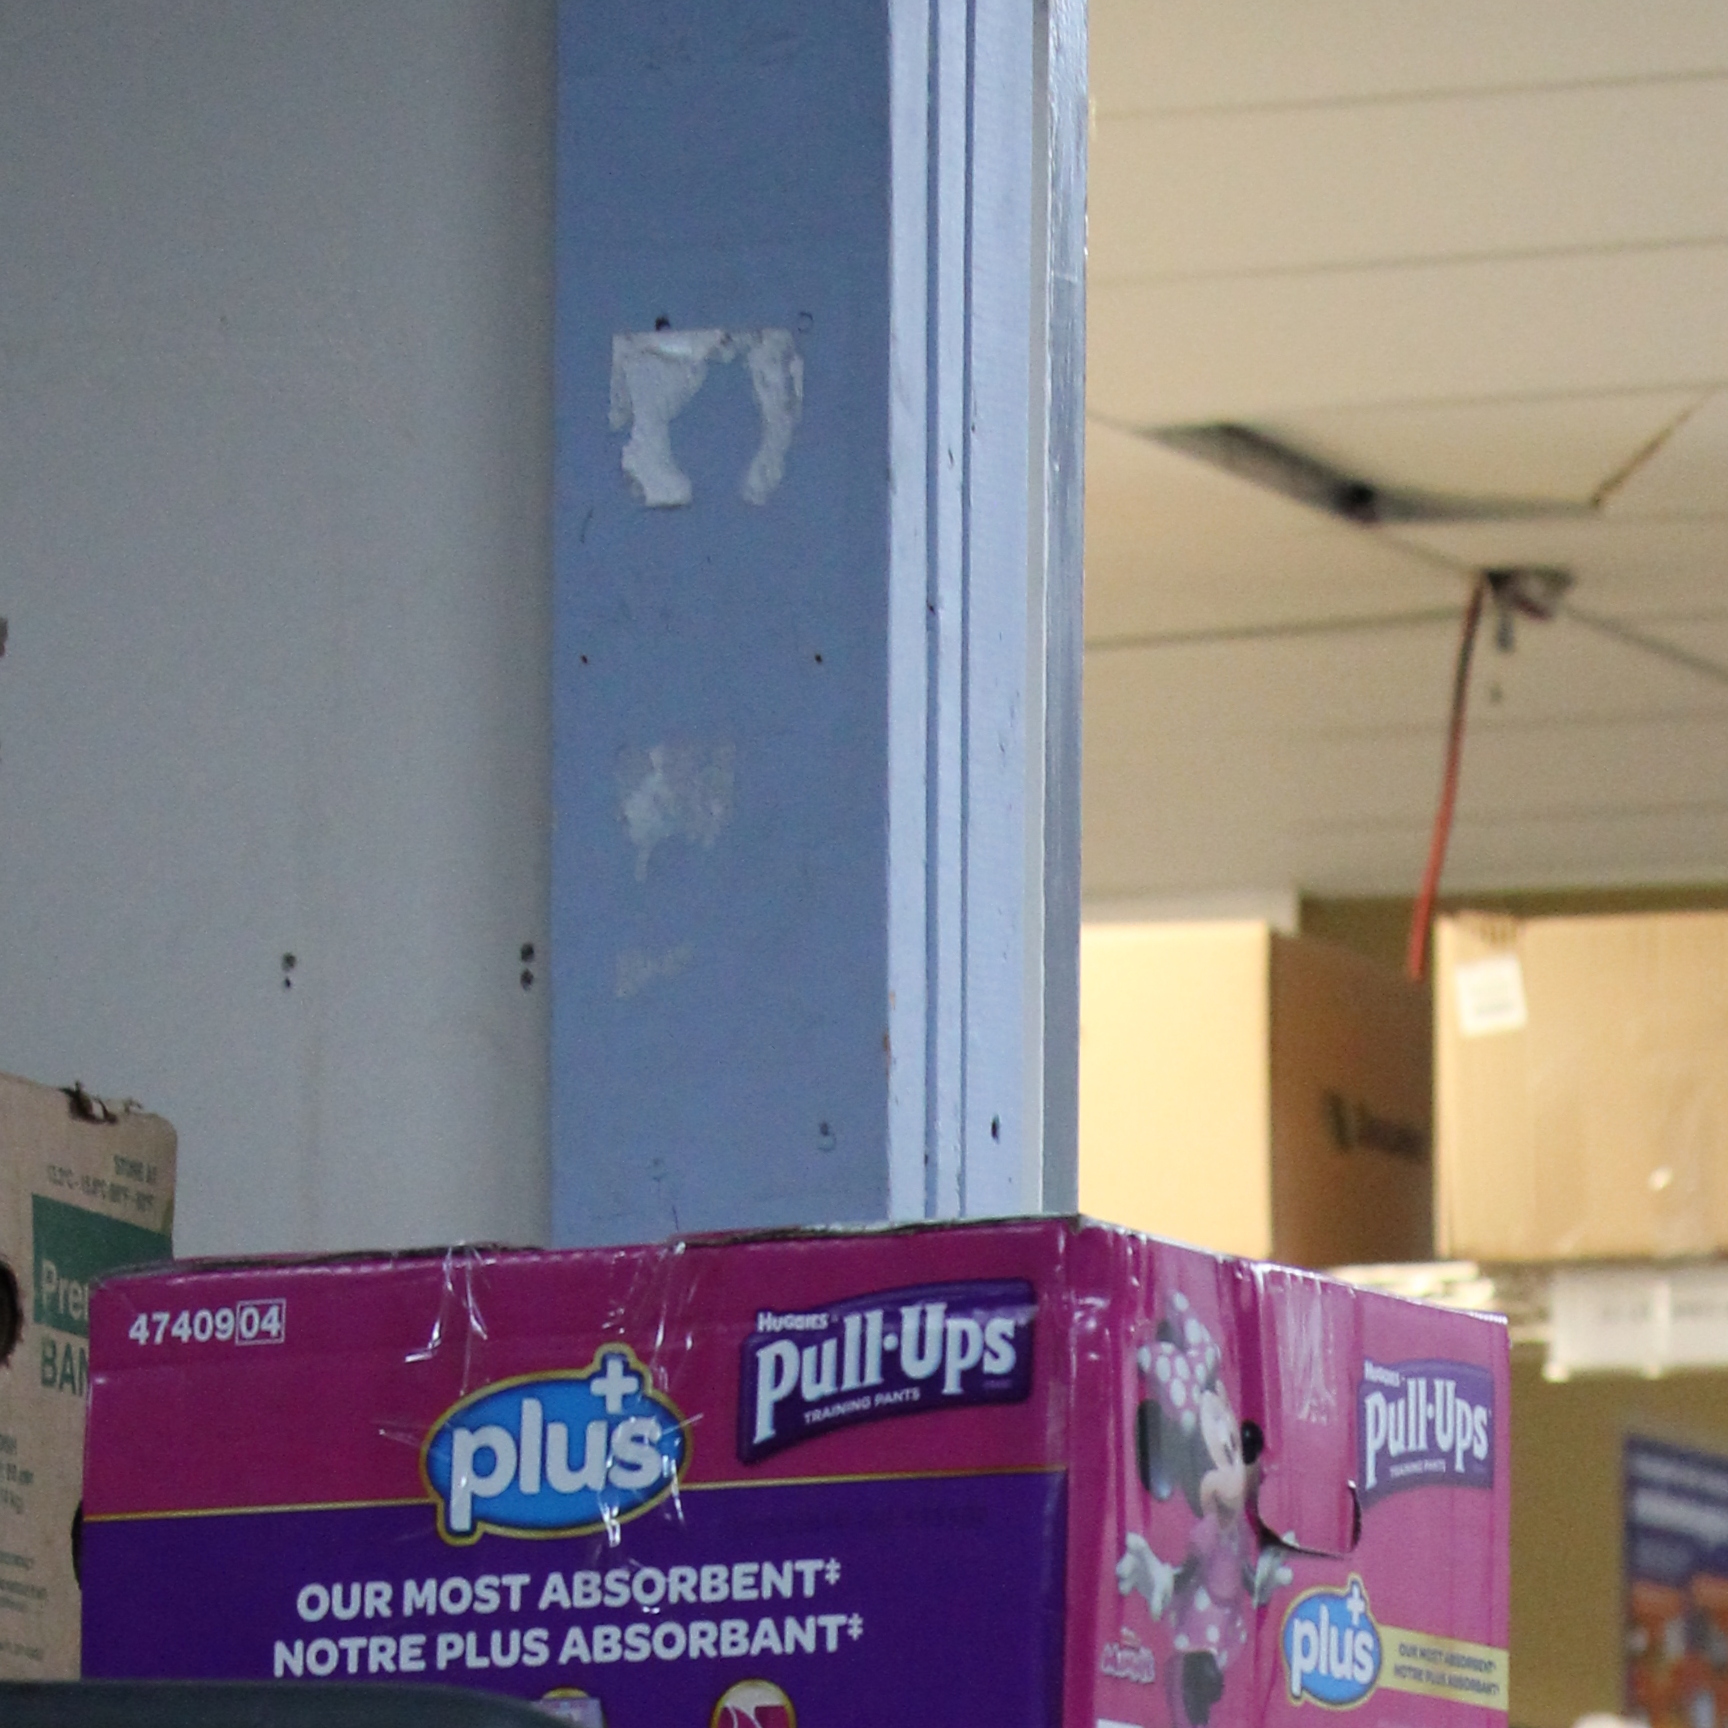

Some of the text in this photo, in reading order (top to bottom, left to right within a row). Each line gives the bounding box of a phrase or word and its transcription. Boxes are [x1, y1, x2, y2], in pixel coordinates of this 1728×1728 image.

[804, 1386, 921, 1425] TRAINING PANTS
[297, 1581, 393, 1621] OUR
[403, 1573, 530, 1616] MOST
[273, 1634, 427, 1679] NOTRE
[437, 1627, 550, 1671] PLUS
